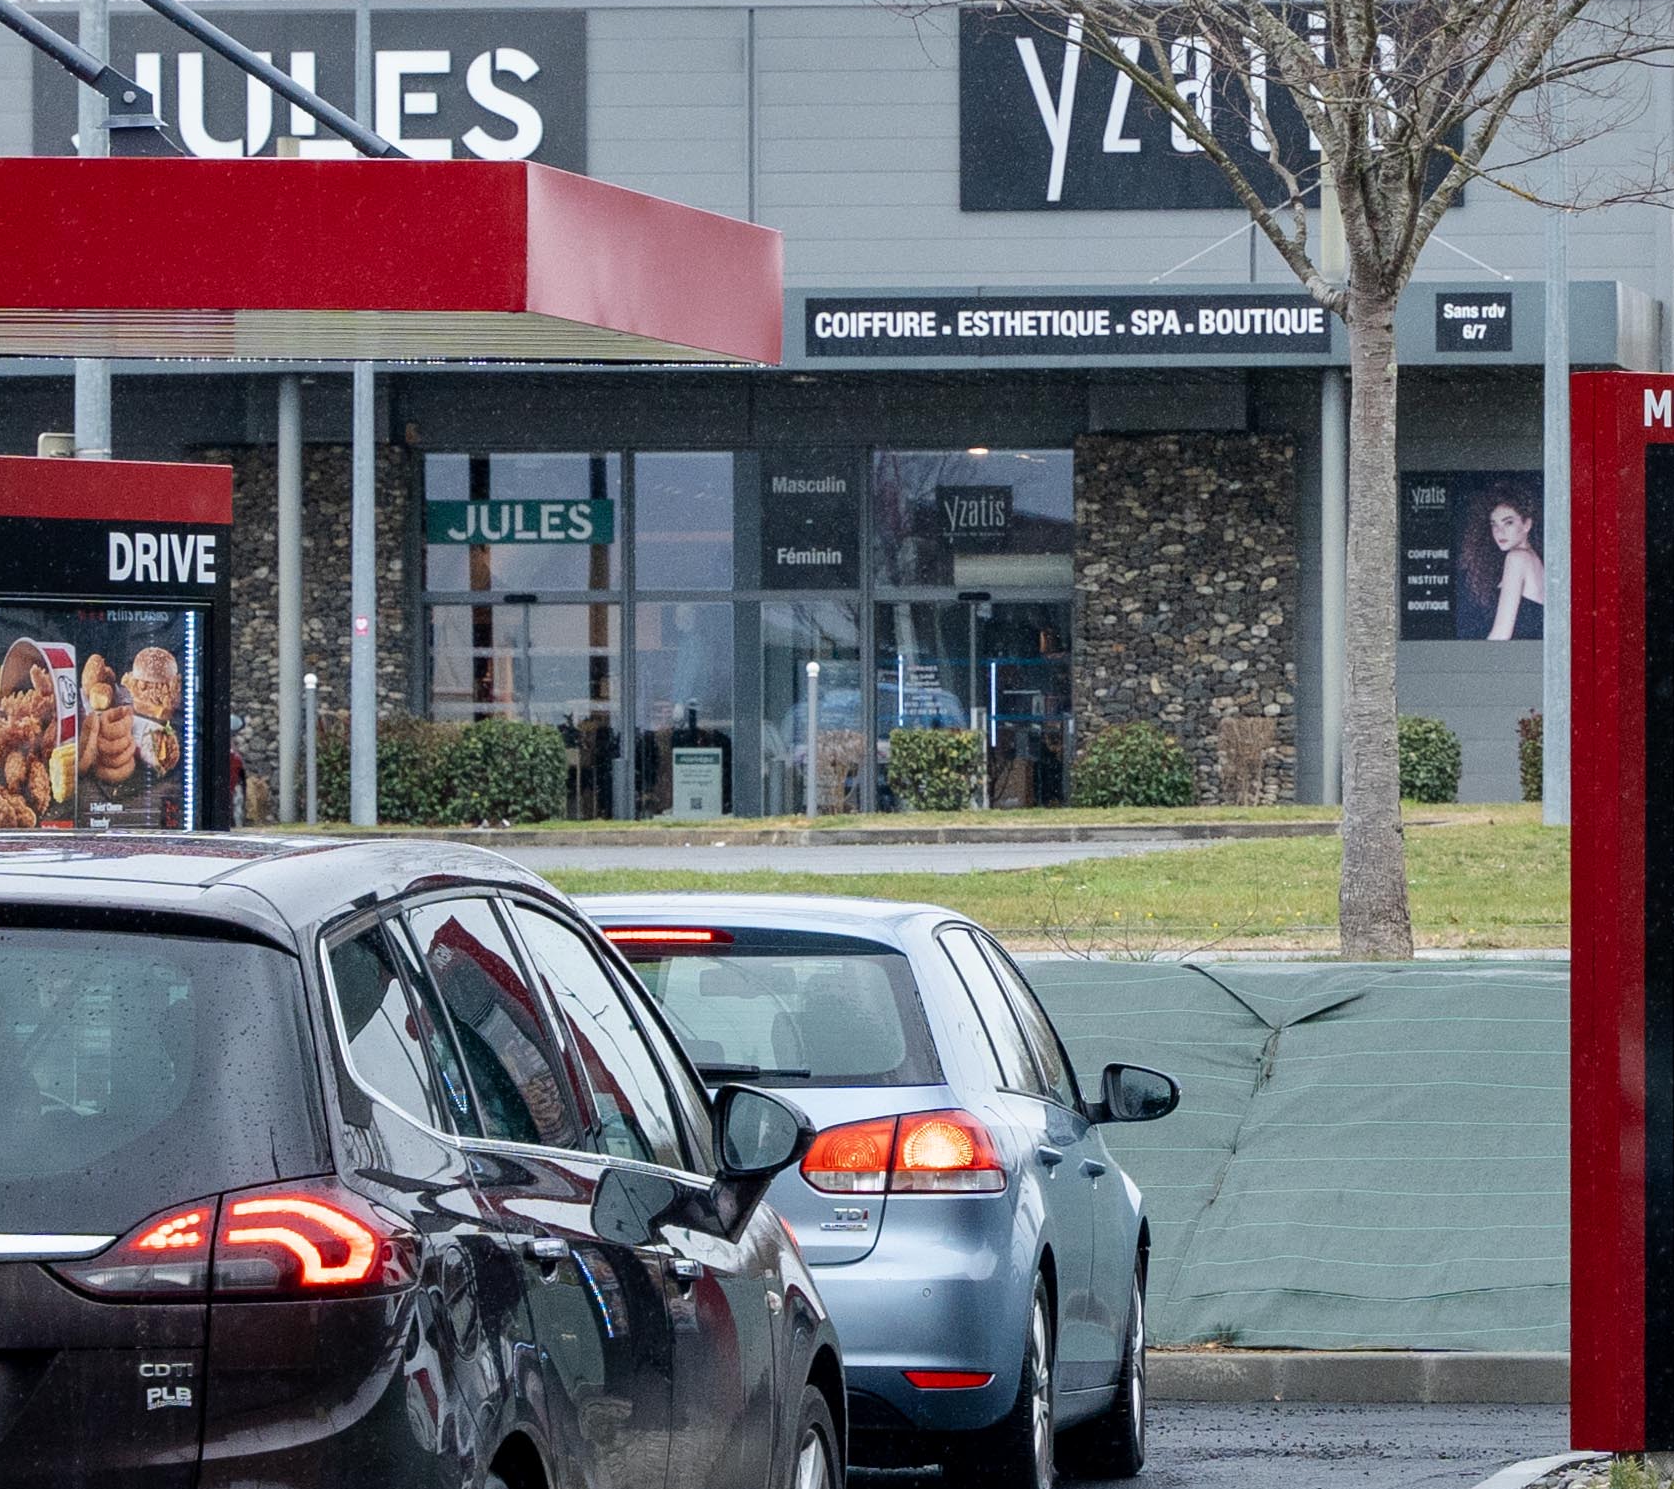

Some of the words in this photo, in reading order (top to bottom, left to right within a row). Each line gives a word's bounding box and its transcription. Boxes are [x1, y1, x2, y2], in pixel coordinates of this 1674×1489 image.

[1443, 303, 1479, 319] Sans
[1482, 303, 1506, 319] rdv
[815, 311, 936, 338] COIFFURE
[958, 310, 1109, 338] ESTHETIQUE
[1131, 309, 1182, 335] SPA
[1199, 308, 1324, 335] BOUTIQUE
[1462, 324, 1487, 339] 6/7
[772, 476, 846, 493] Masculin
[944, 495, 1006, 531] yzatis
[447, 503, 593, 541] JULES
[109, 532, 216, 584] DRIVE
[777, 547, 842, 565] Féminin
[1407, 549, 1449, 559] COIFFURE
[1408, 575, 1449, 585] INSTITUT
[1407, 601, 1450, 611] BOUTIQUE
[833, 1207, 869, 1221] TDI
[139, 1363, 193, 1377] CDTI
